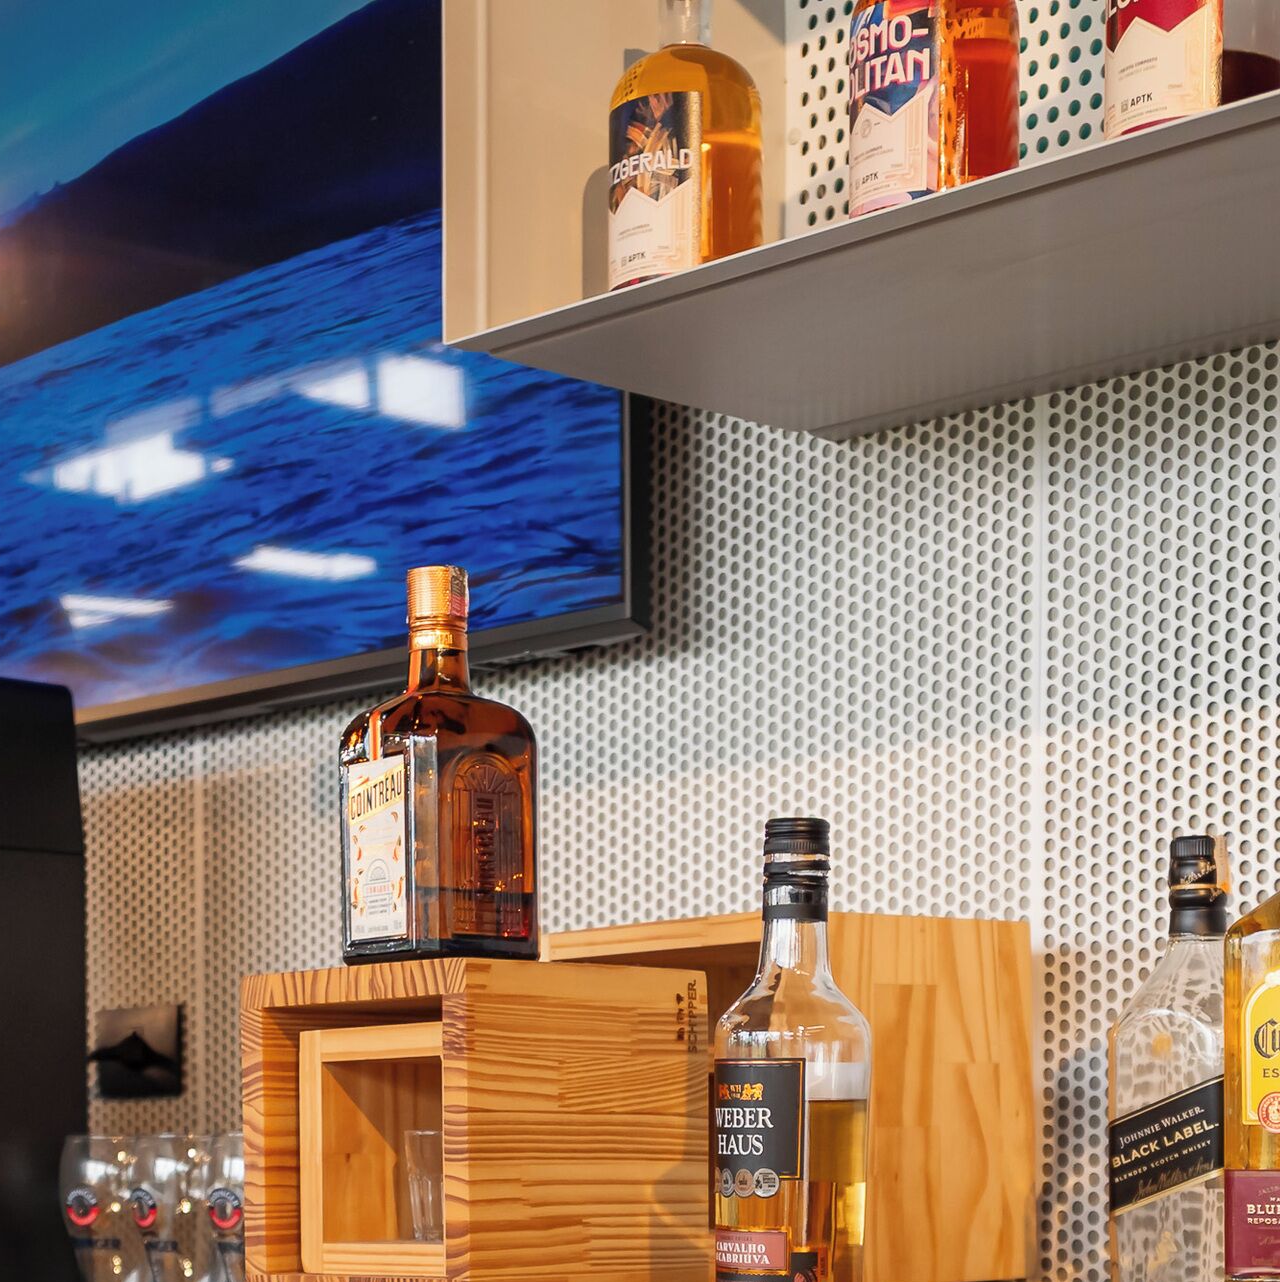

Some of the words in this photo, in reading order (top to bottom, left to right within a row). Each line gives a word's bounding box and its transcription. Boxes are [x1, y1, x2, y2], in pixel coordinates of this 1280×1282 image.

[1130, 92, 1153, 107] APTK
[350, 768, 403, 821] COINTREAU
[715, 1107, 774, 1129] WEBER
[717, 1134, 764, 1156] HAUS
[1119, 1123, 1162, 1149] JOHNNIE
[1111, 1140, 1161, 1168] BLACK
[1114, 1166, 1148, 1184] BLENDED
[1150, 1153, 1180, 1169] SCOTCH
[1182, 1140, 1212, 1156] WHISKY
[716, 1241, 766, 1254] CARVALHO
